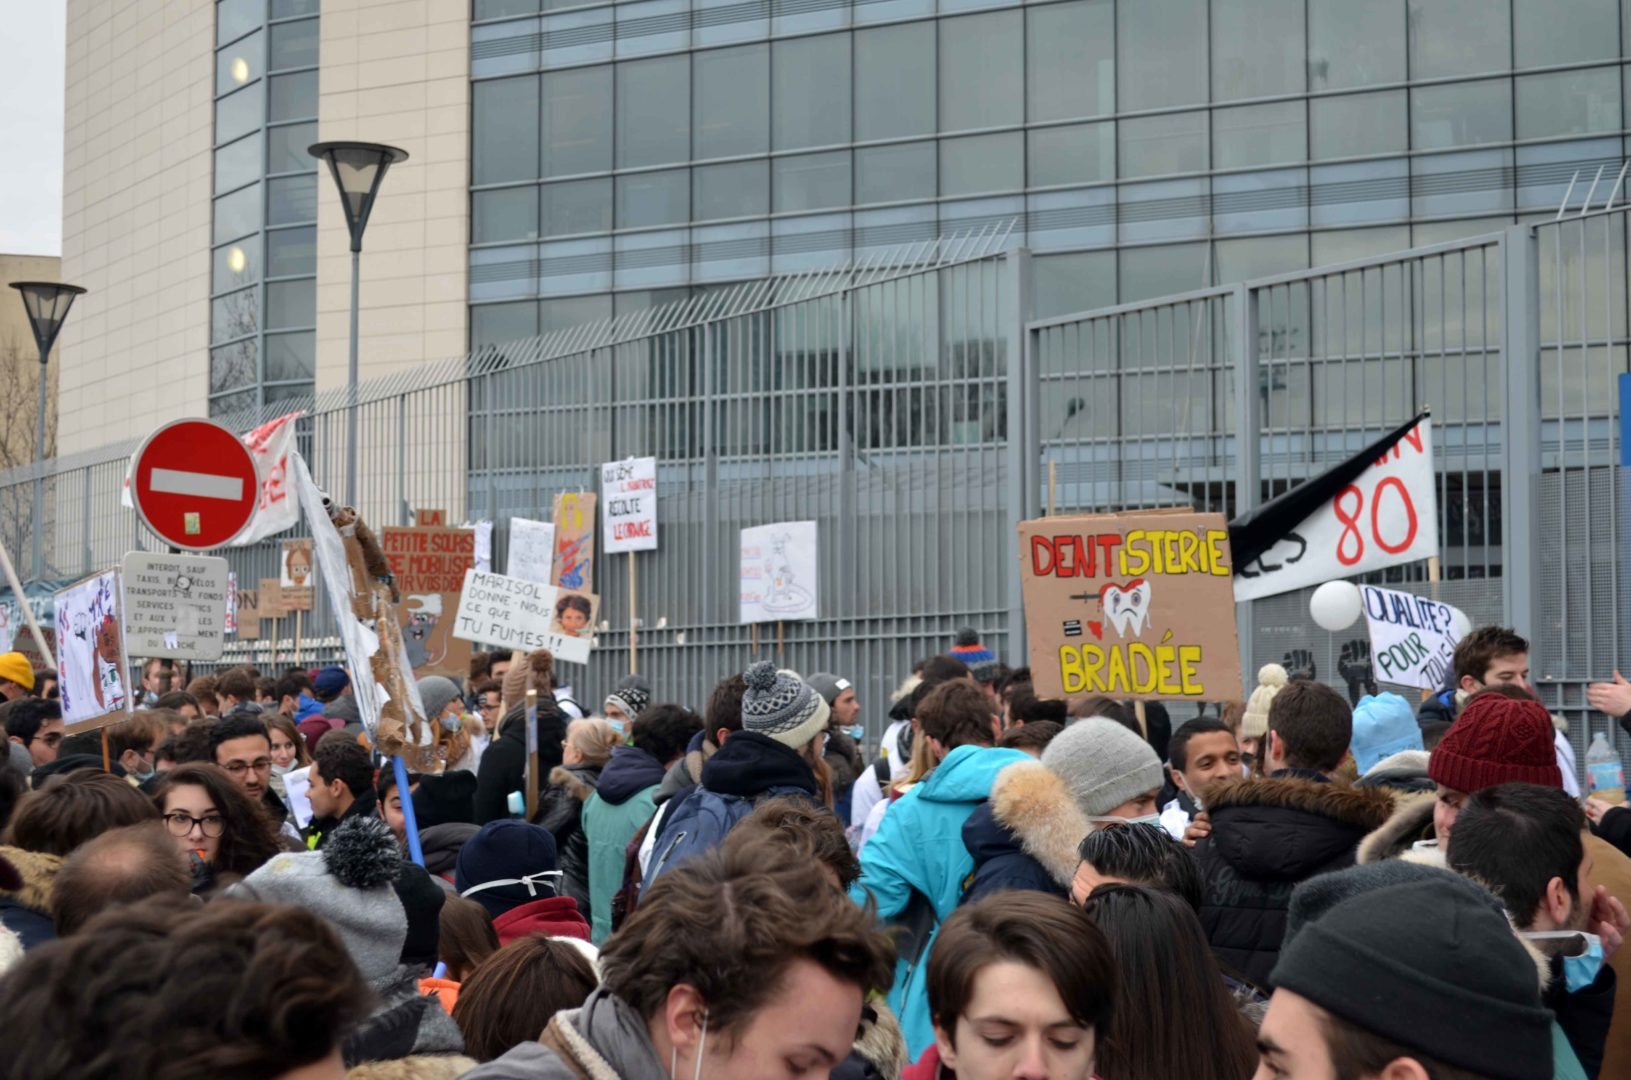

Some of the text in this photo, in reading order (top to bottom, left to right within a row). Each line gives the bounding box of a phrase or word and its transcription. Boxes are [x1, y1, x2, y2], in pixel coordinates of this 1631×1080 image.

[420, 511, 441, 526] LA
[1333, 476, 1418, 566] 80
[384, 532, 474, 553] PETITE SOURIS
[1031, 529, 1230, 578] DENTISTERIE
[147, 562, 206, 574] INTERDIT SAUF
[418, 575, 441, 592] VOS
[472, 573, 542, 599] MARISOL
[126, 587, 177, 598] TRANSPORTS
[198, 592, 224, 602] FONDS
[136, 600, 174, 610] SERVICES
[466, 602, 511, 620] CE QUE
[134, 613, 143, 621] ET
[150, 614, 165, 623] AUX
[460, 617, 483, 634] TU
[147, 639, 159, 648] DU
[1059, 628, 1204, 695] BRADÉE
[1377, 632, 1430, 679] POUR
